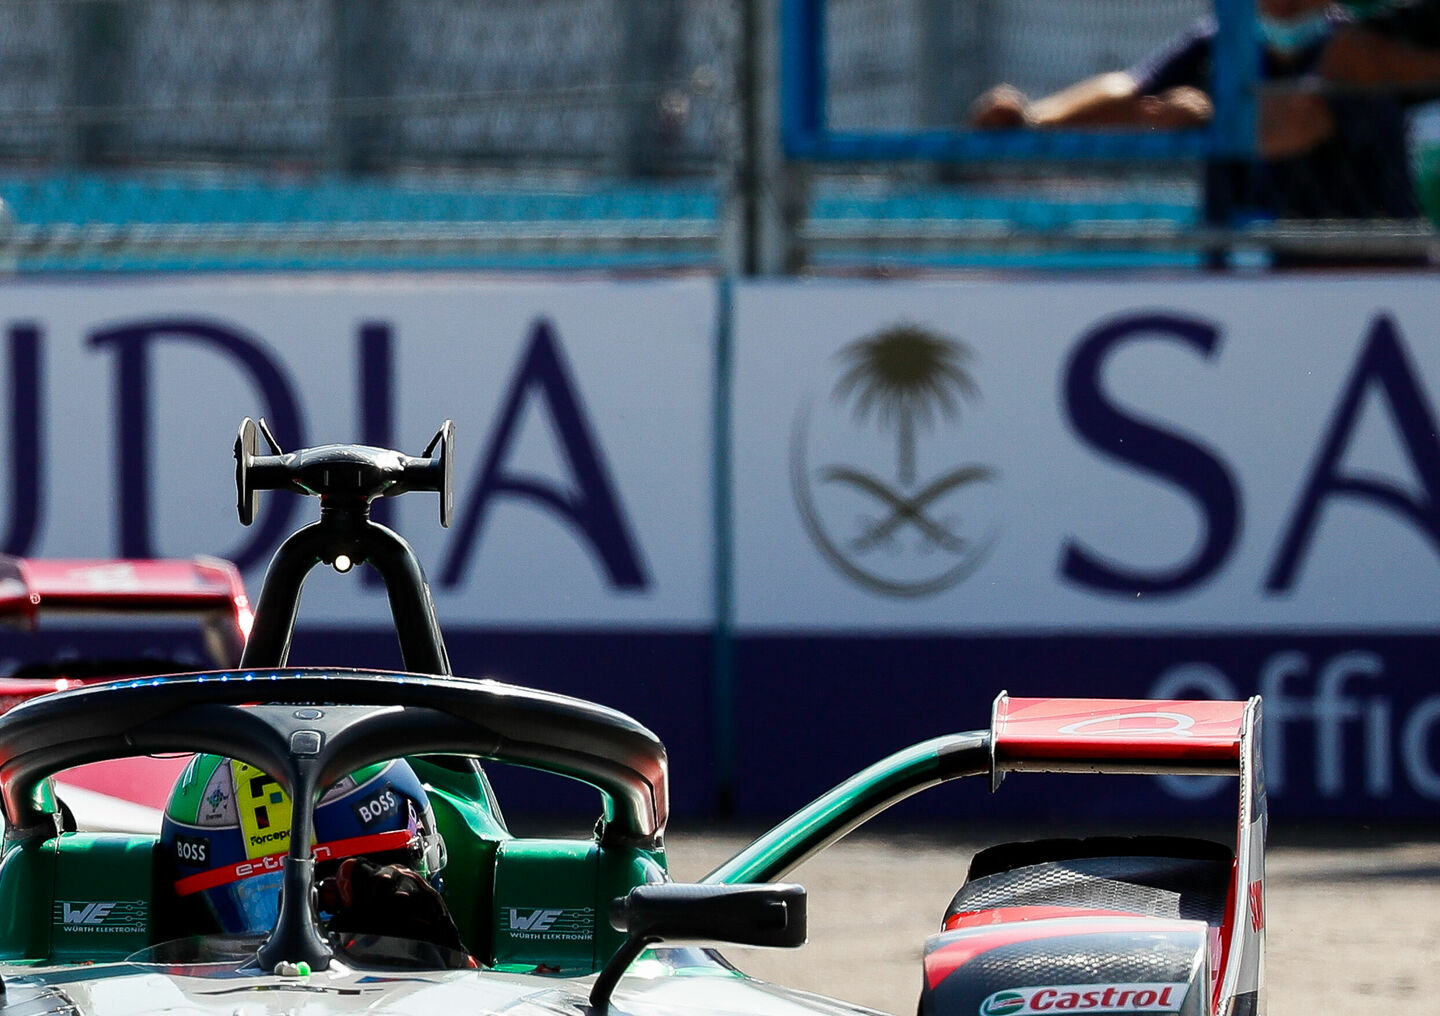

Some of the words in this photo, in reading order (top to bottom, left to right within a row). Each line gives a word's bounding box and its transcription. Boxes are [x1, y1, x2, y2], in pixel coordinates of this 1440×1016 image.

[359, 790, 396, 823] BOSS
[176, 840, 207, 862] BOSS
[235, 846, 332, 876] e-trn
[63, 902, 117, 924] WE
[509, 908, 564, 931] WE
[542, 933, 593, 941] ELEKTRONIK
[1028, 986, 1173, 1011] Castrol
